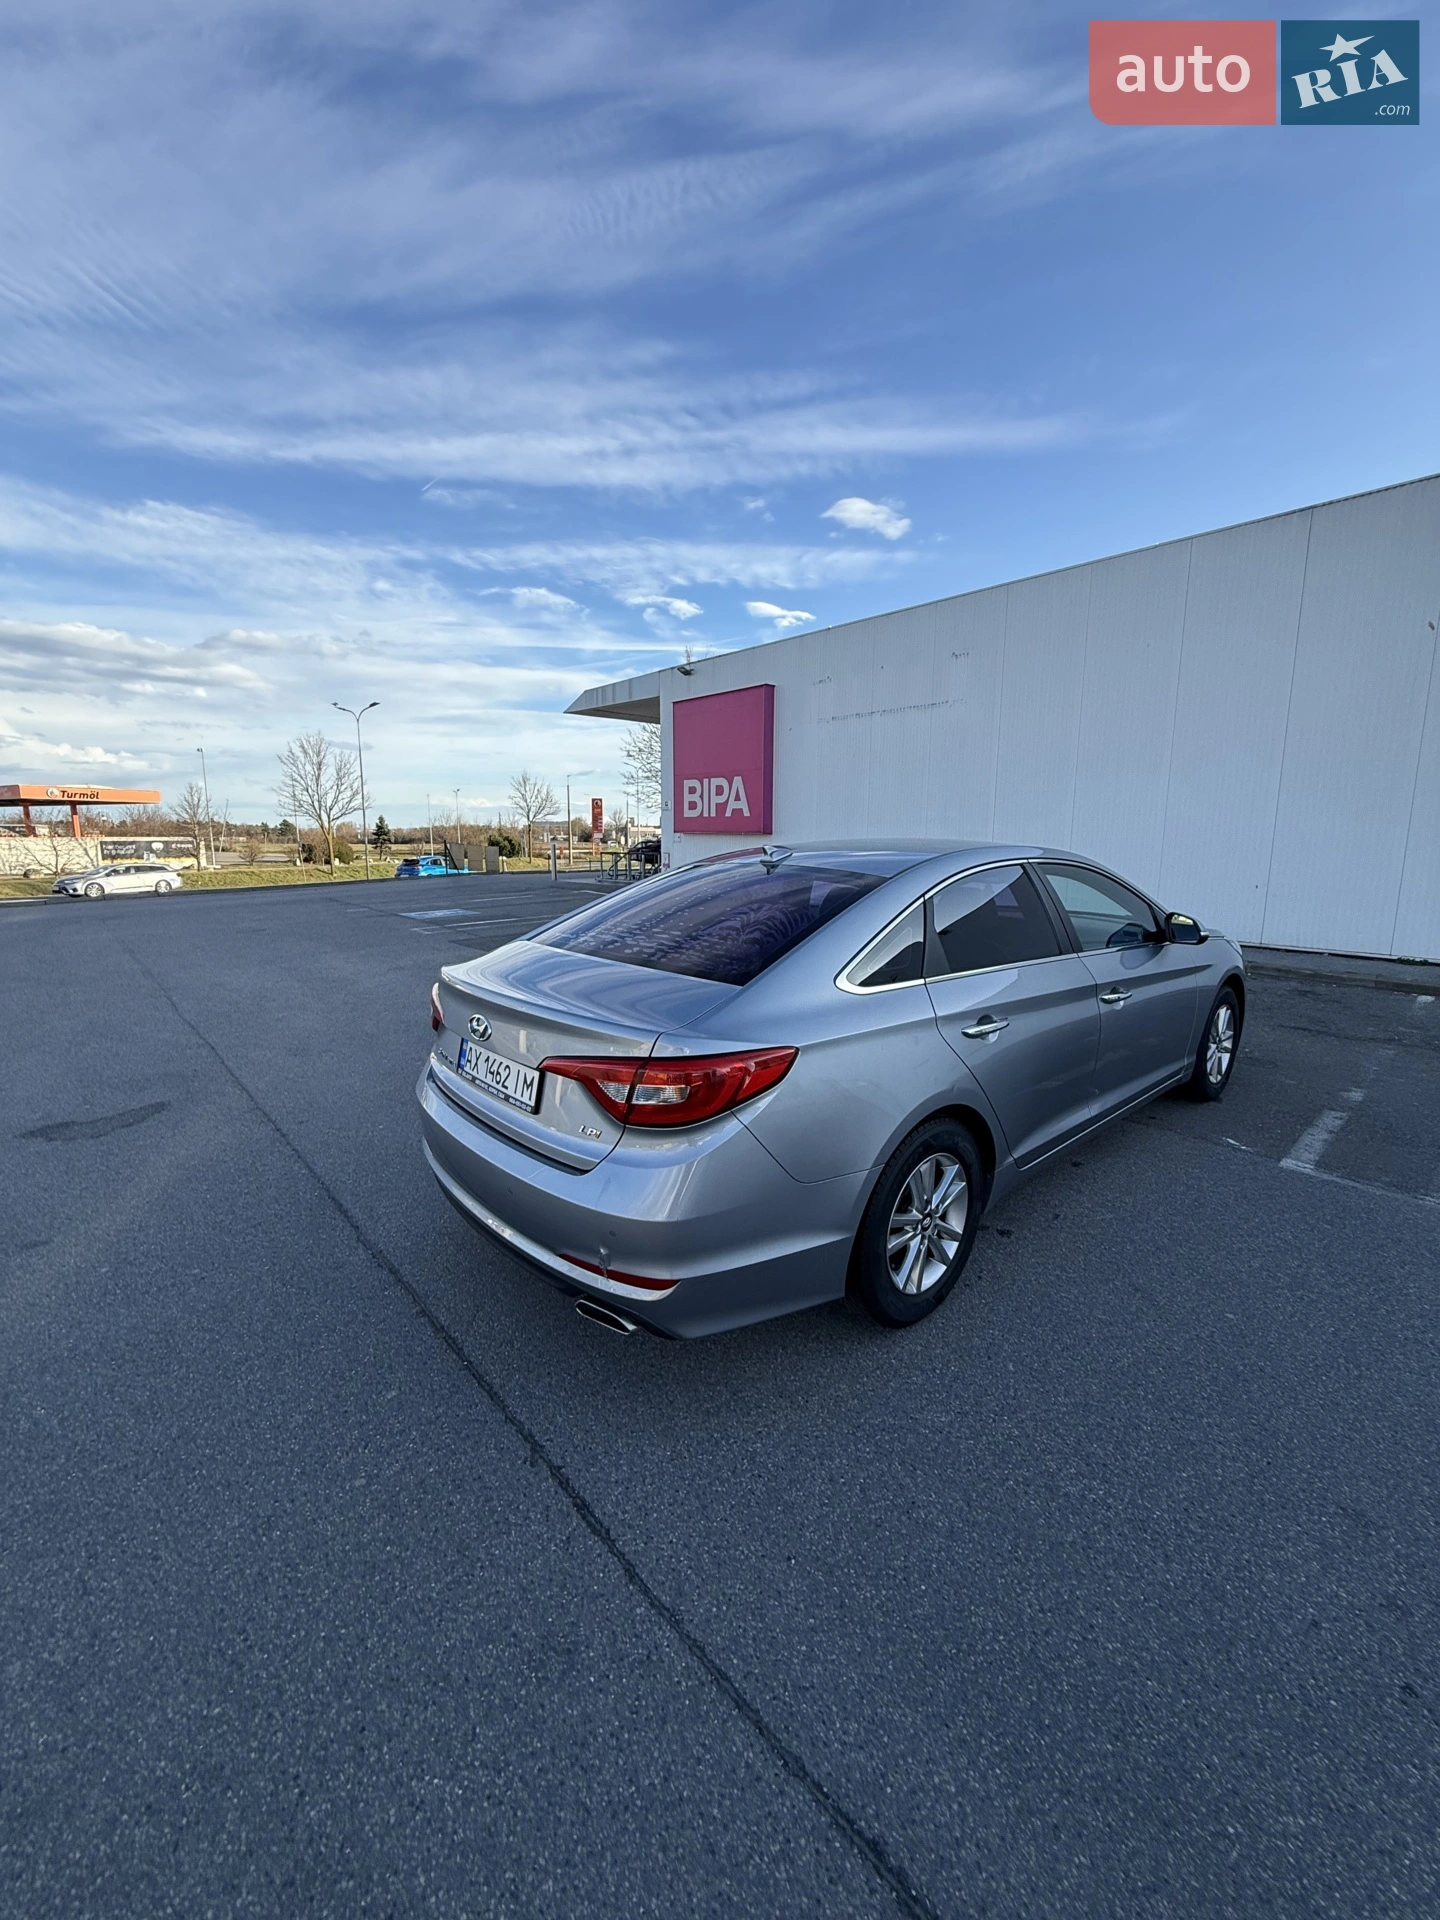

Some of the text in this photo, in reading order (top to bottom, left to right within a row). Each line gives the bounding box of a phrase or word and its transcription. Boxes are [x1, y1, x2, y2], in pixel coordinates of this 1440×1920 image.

[60, 790, 99, 800] Turmöl
[683, 776, 751, 818] BIPA
[465, 1046, 482, 1075] AX
[484, 1055, 511, 1091] 1462
[514, 1069, 535, 1102] IM
